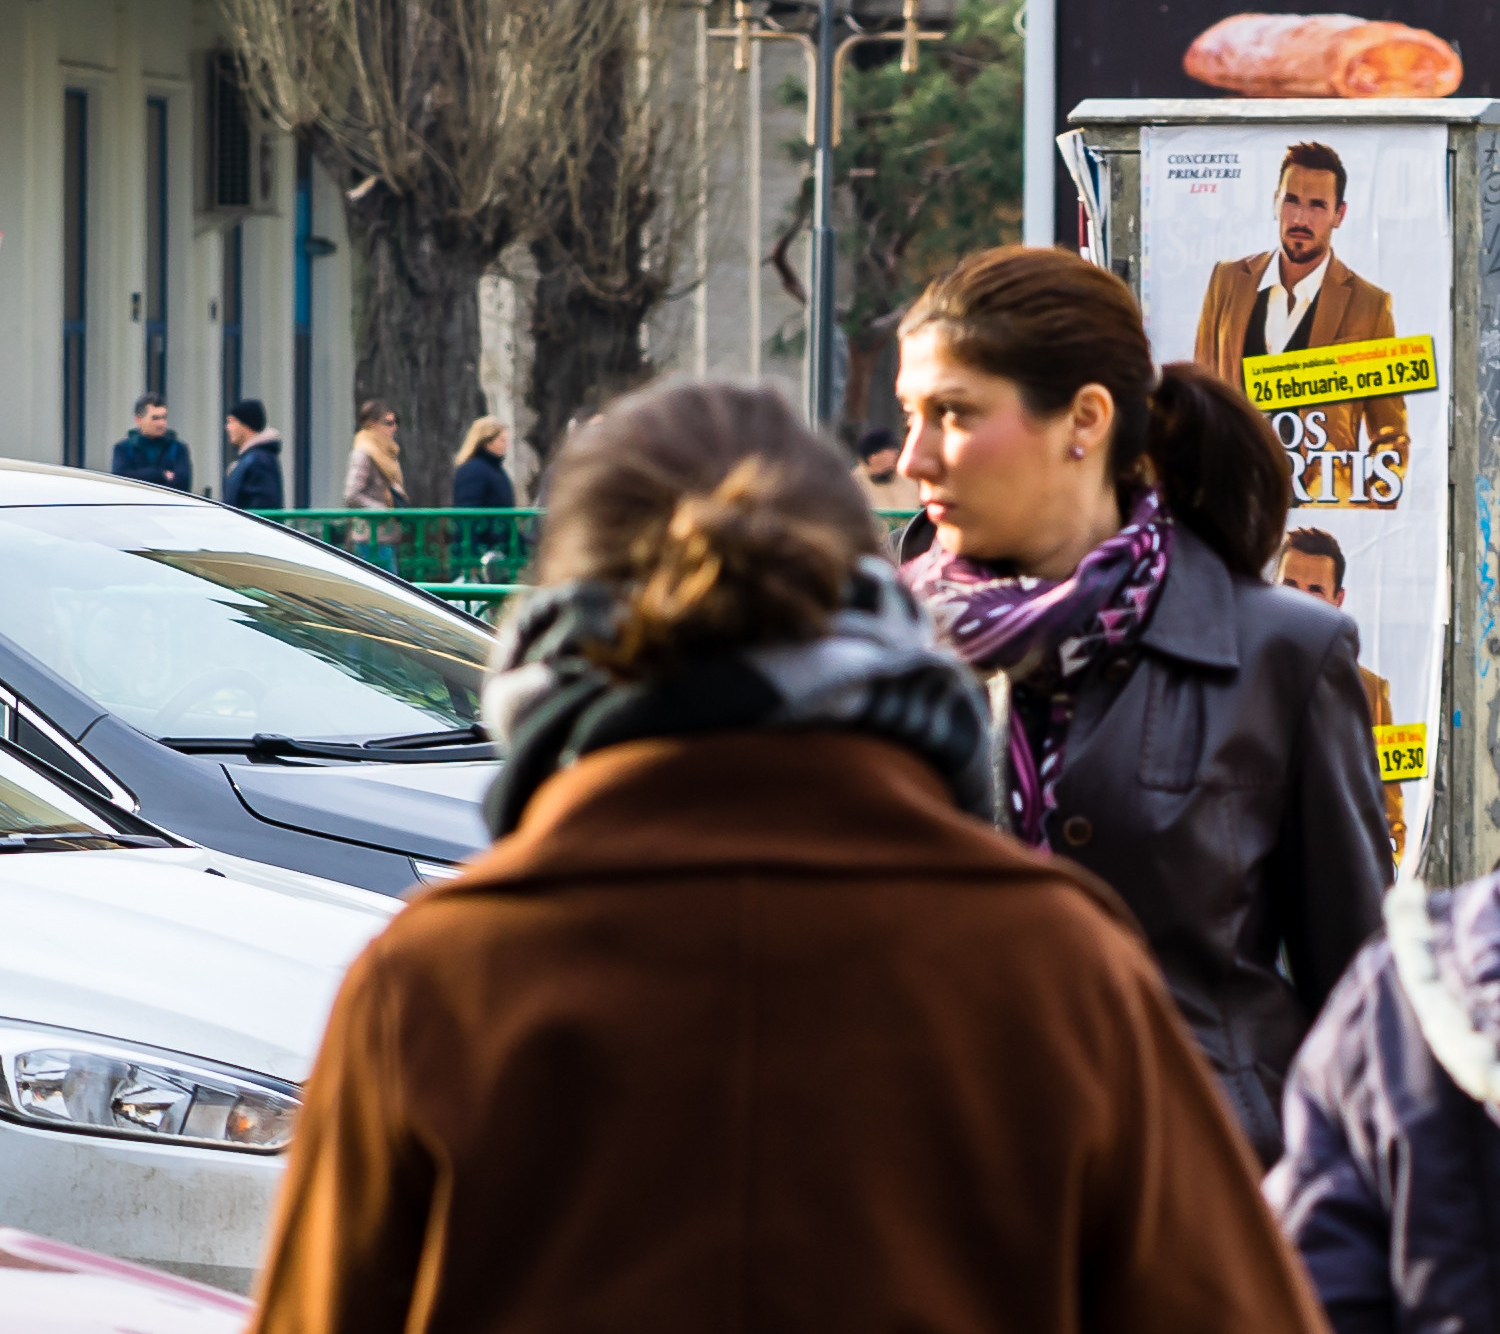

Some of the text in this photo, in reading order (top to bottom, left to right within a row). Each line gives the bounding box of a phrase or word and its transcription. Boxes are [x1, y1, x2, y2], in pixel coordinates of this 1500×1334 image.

[1166, 153, 1241, 165] CONCERTUL
[1252, 358, 1430, 403] 26 februarie, ora 19:30
[1383, 746, 1424, 772] 19:30
